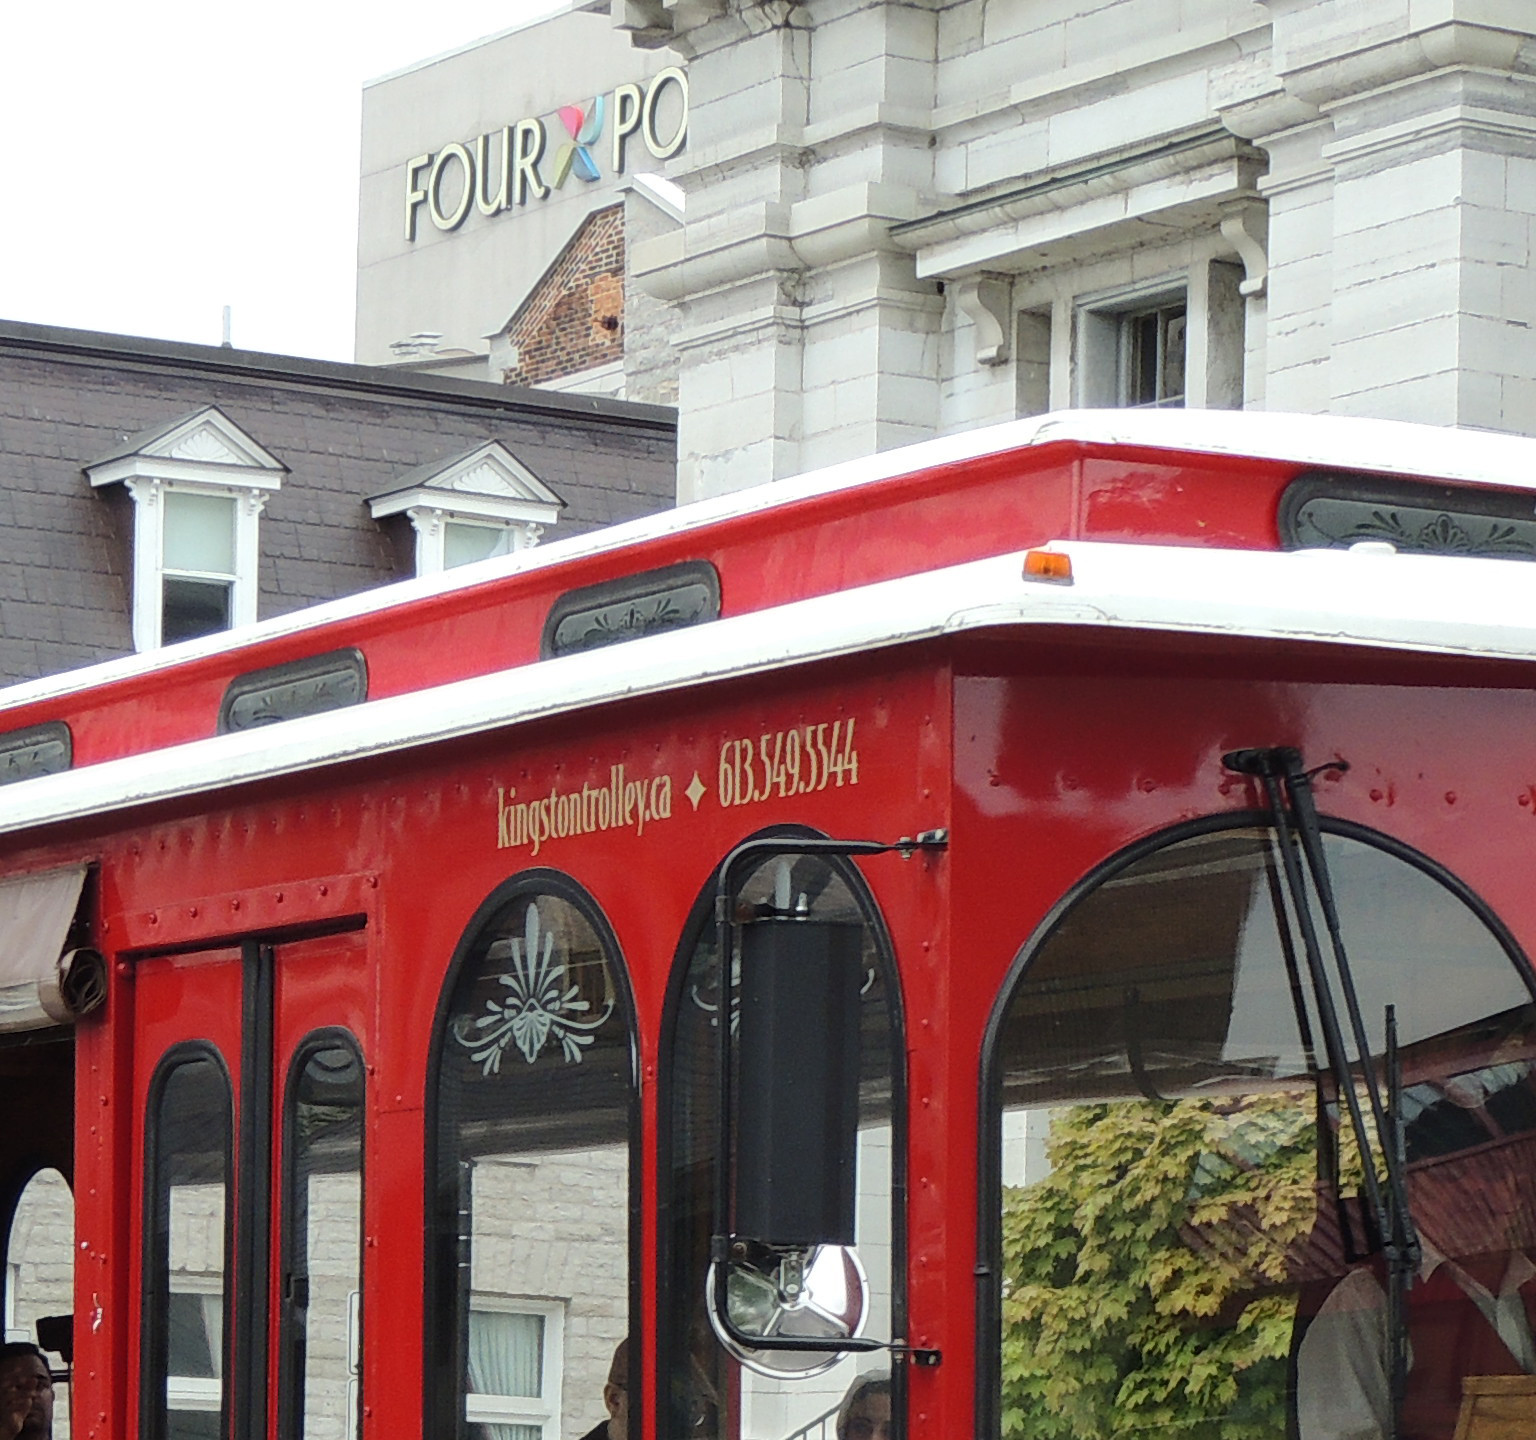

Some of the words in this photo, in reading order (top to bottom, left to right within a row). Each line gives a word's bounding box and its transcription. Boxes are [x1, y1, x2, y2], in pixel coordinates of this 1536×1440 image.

[404, 117, 551, 241] FOUR
[612, 66, 689, 173] PO
[497, 764, 672, 856] kingstontrolley.ca
[719, 718, 858, 807] 613.549.5544
